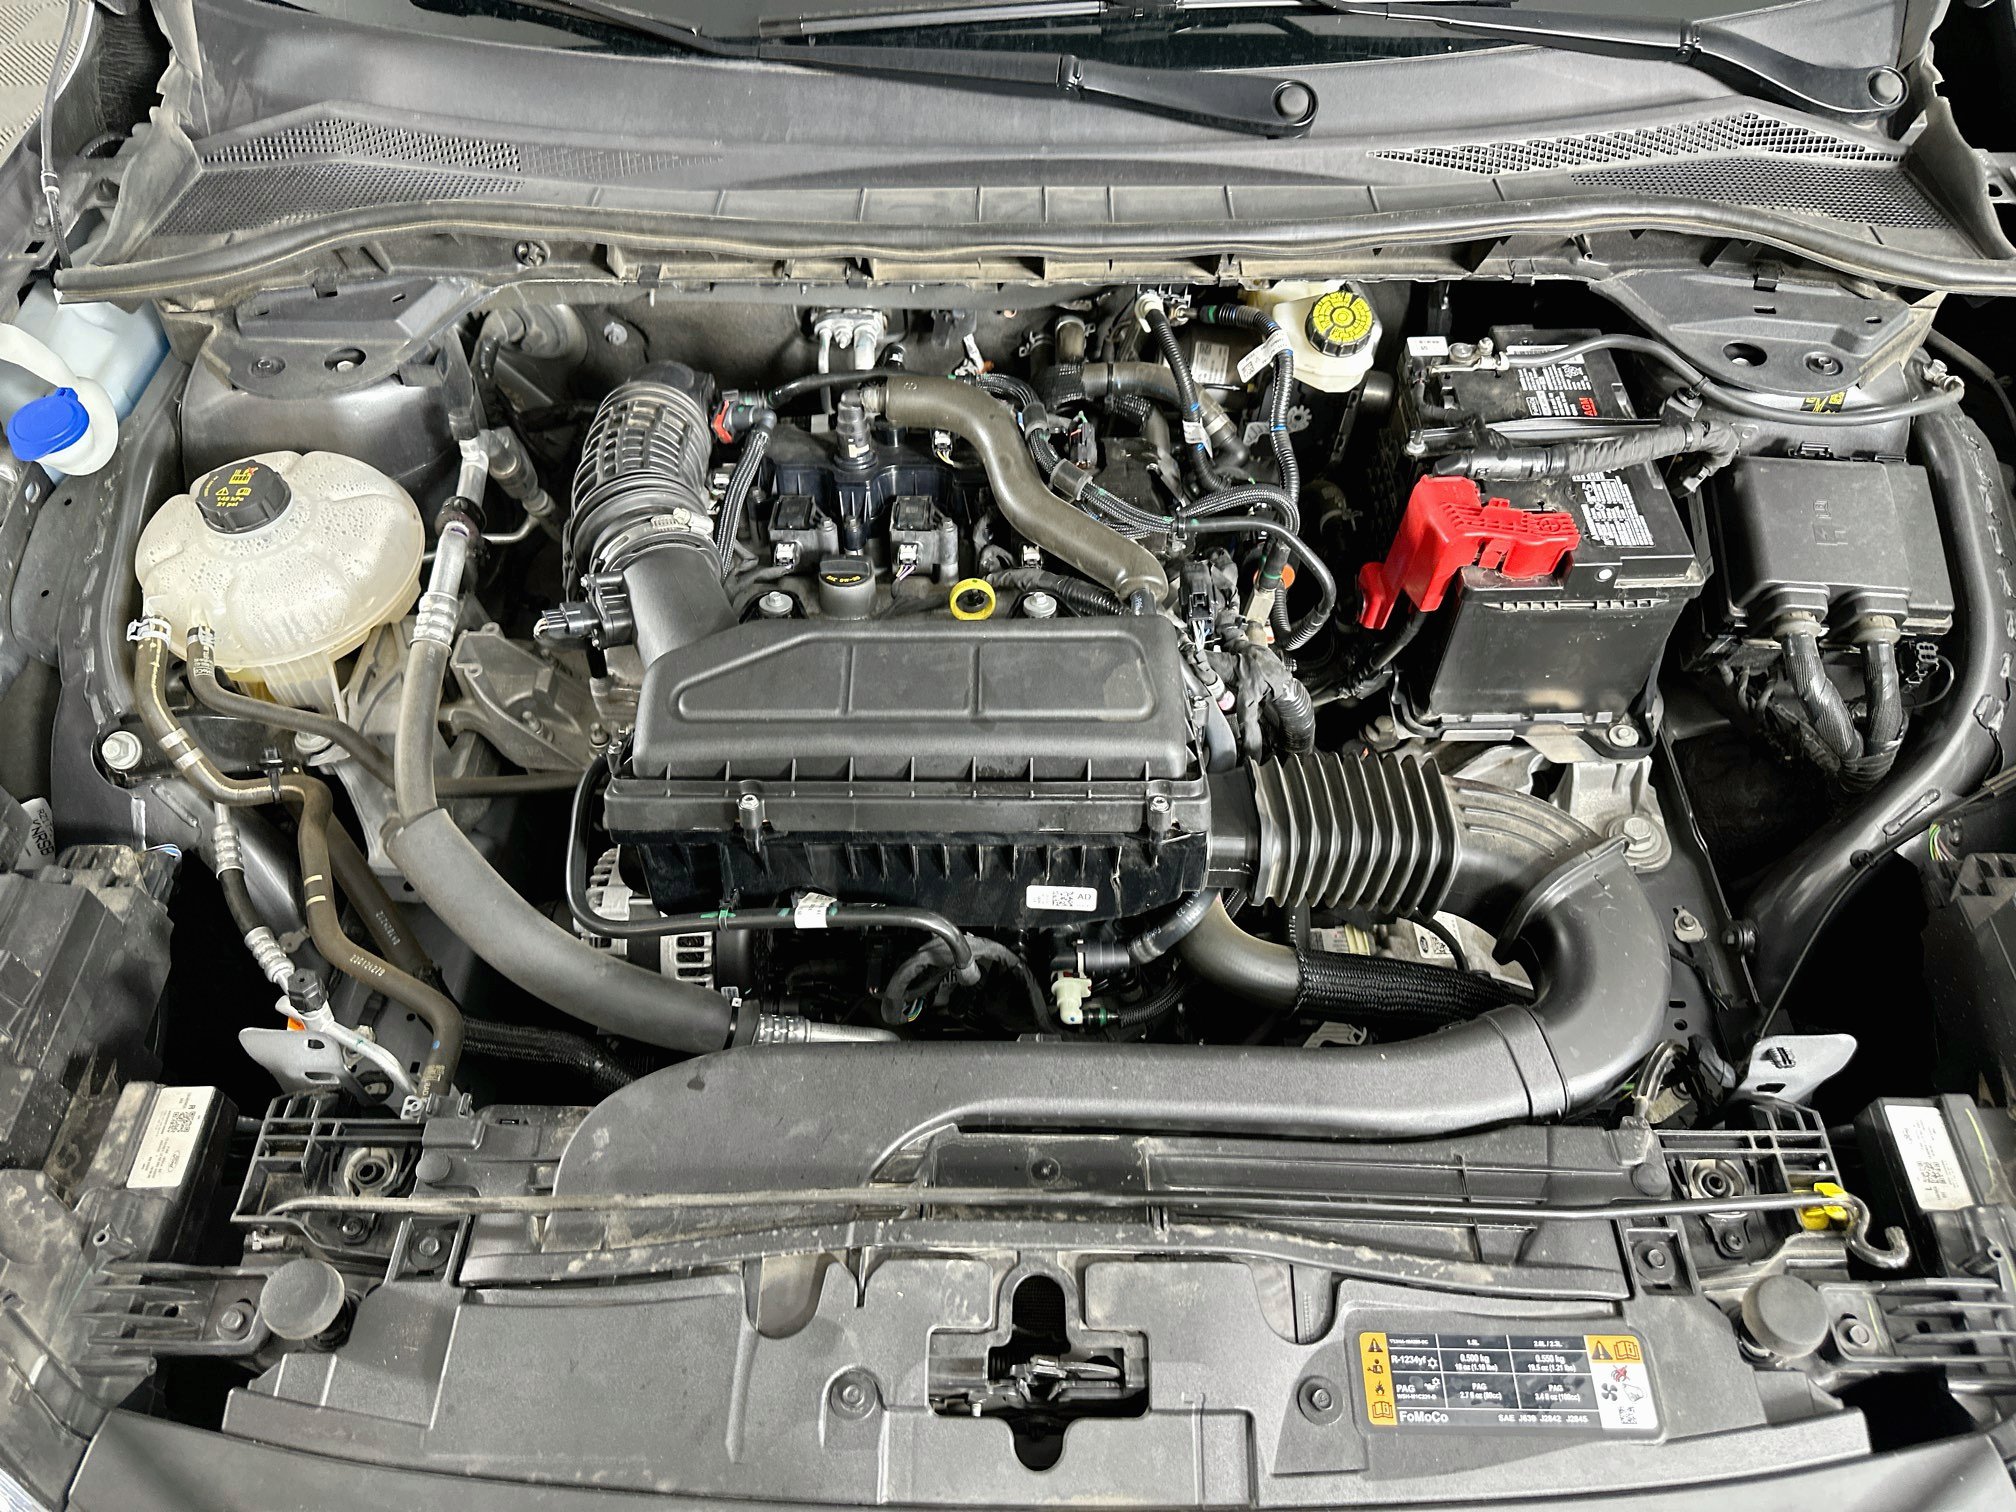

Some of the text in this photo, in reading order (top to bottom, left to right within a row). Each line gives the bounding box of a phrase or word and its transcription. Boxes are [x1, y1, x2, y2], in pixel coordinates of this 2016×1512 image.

[1578, 397, 1594, 416] AGM
[1391, 1355, 1427, 1366] R-1234yf
[1460, 1353, 1490, 1364] 0.500 kg
[1554, 1354, 1566, 1364] kg
[1395, 1384, 1416, 1393] PAG
[1471, 1382, 1488, 1391] PAG
[1548, 1384, 1564, 1392] PAG
[1399, 1411, 1449, 1423] FoMoCo
[1498, 1413, 1516, 1422] SAE
